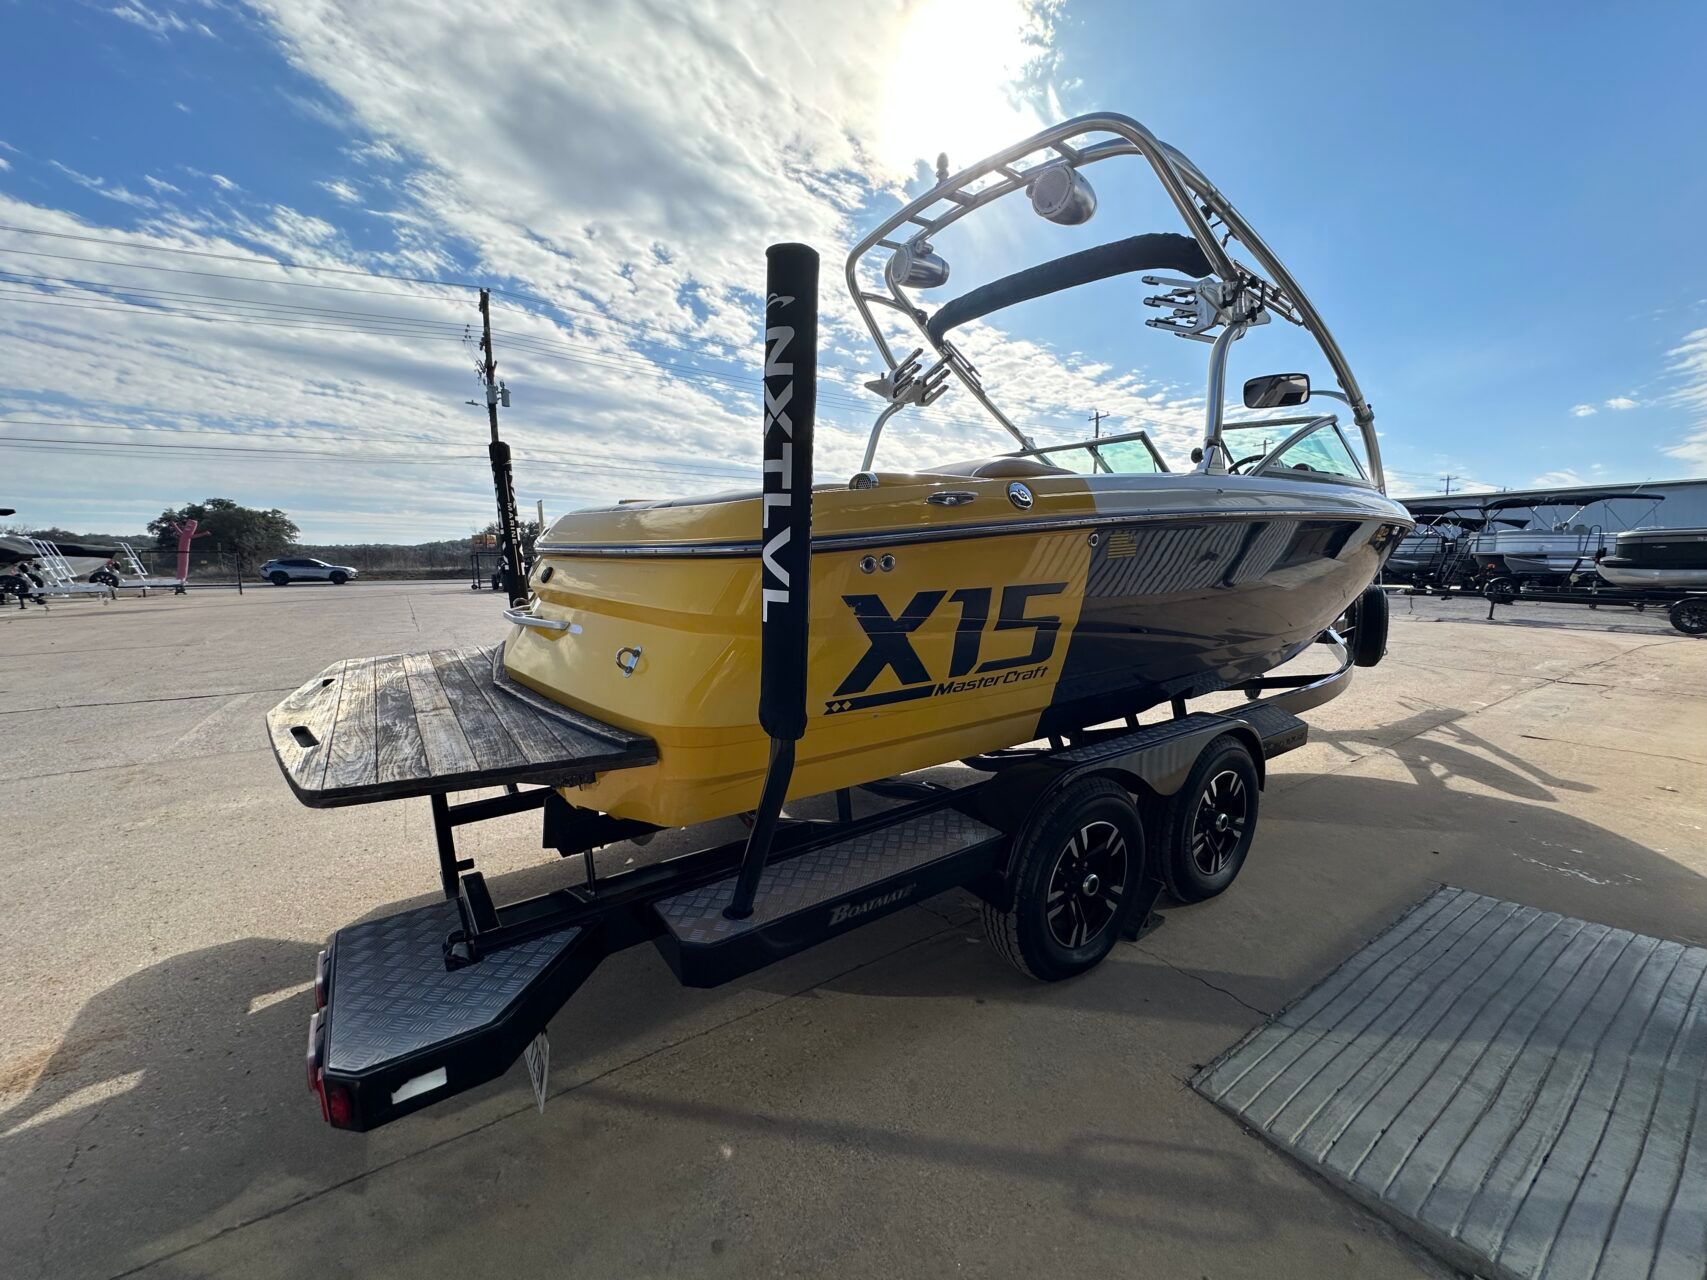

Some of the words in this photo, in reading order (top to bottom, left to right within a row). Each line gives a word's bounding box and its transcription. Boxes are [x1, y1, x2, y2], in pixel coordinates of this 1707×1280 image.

[762, 325, 795, 622] NXTLVL
[506, 501, 518, 545] MARINE
[833, 582, 1069, 697] X15
[934, 666, 1049, 697] MasterCraft
